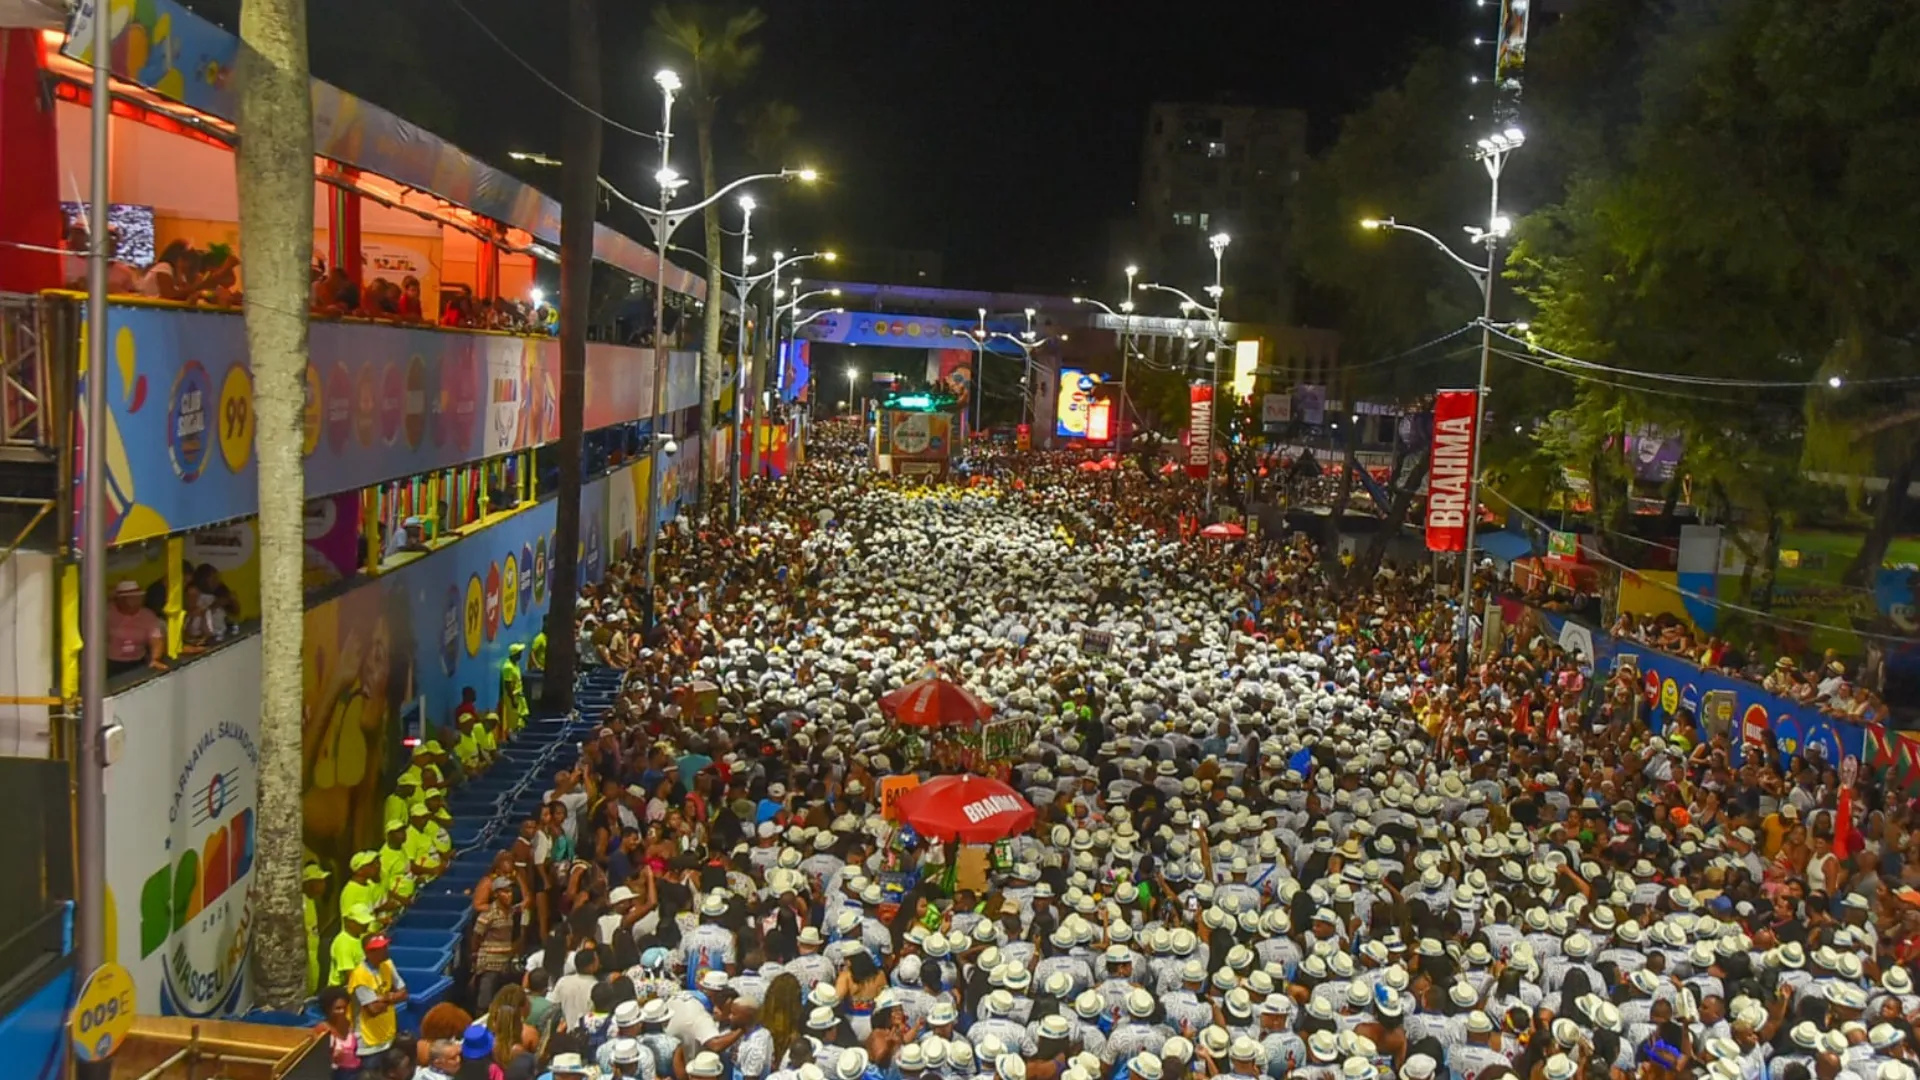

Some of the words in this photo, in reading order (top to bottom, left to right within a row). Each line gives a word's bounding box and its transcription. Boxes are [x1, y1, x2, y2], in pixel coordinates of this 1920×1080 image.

[226, 396, 248, 440] 99
[1190, 400, 1212, 466] BRAHMA
[1429, 416, 1472, 528] BRAHMA
[168, 728, 216, 823] CARNAVAL
[962, 794, 1023, 824] BRAHMA
[80, 988, 130, 1034] 009E
